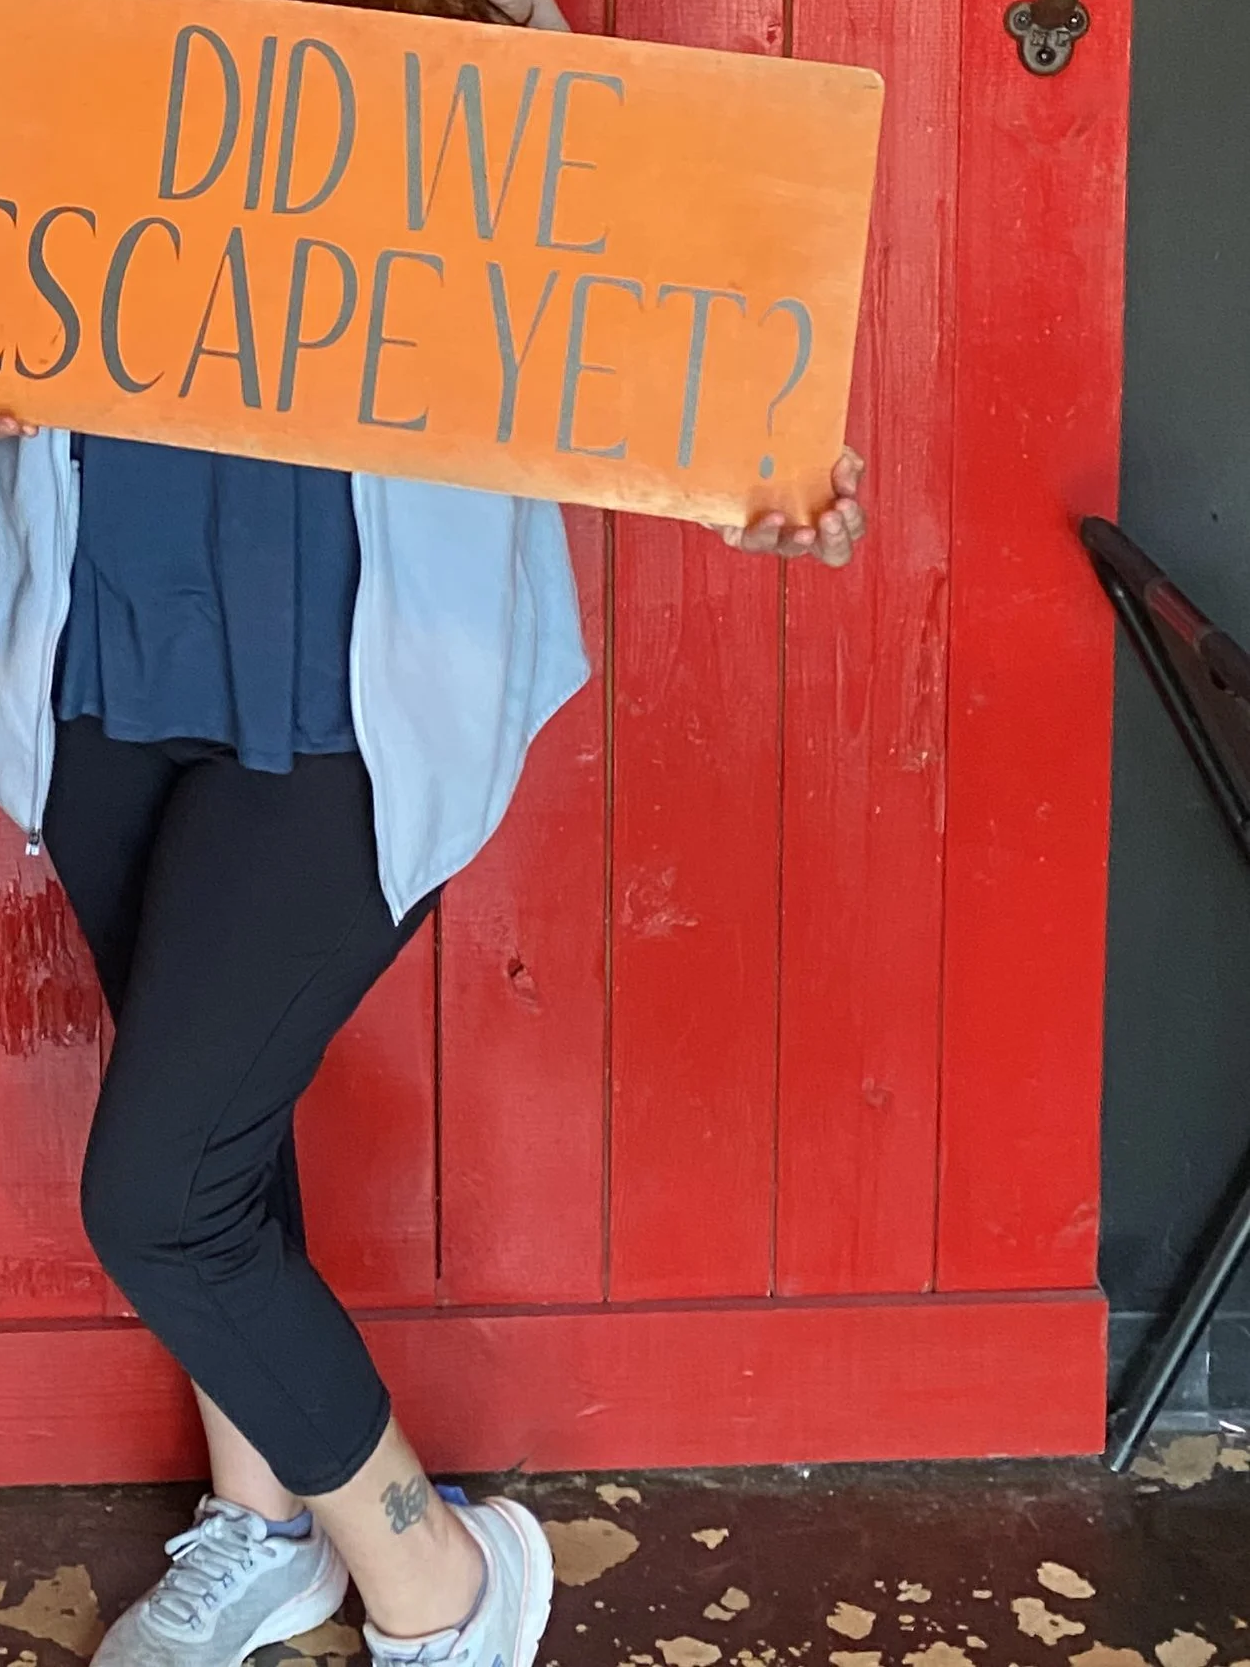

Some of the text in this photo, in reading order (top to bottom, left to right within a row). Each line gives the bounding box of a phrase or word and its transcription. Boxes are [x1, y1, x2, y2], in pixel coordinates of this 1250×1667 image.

[157, 24, 625, 254] DID WE
[486, 261, 813, 480] YET?
